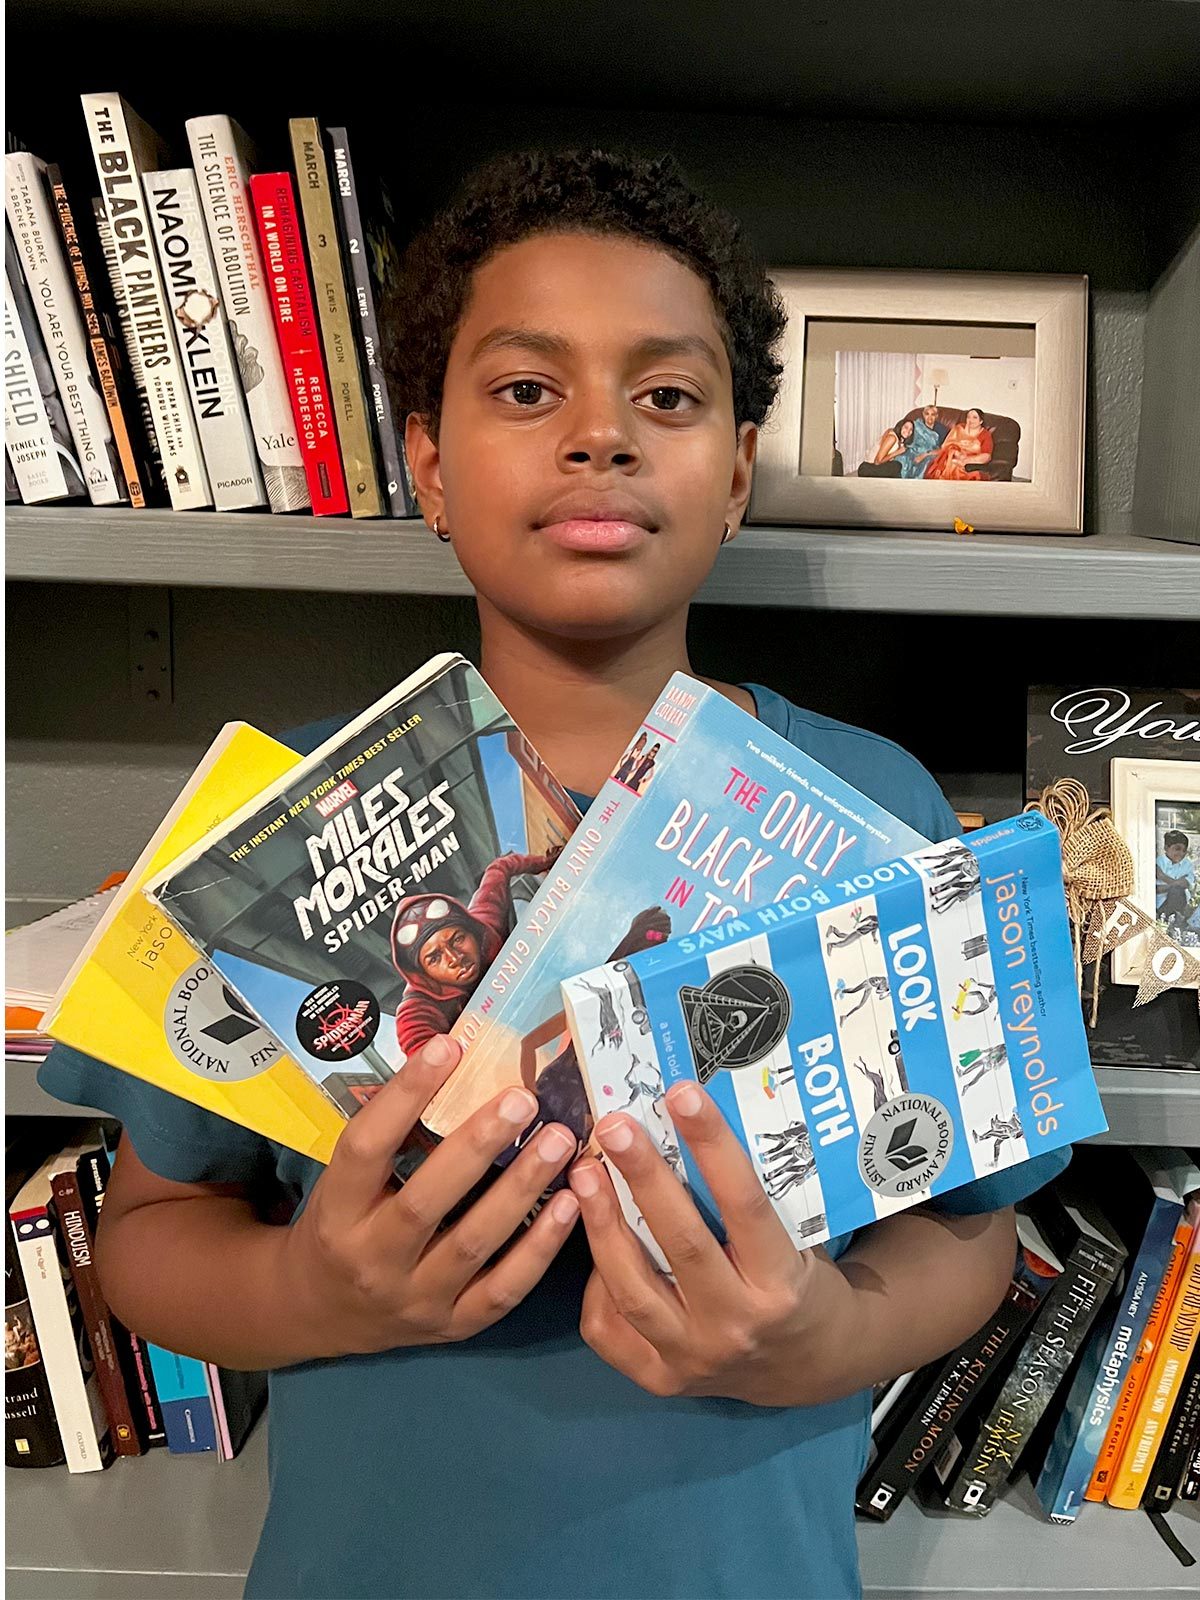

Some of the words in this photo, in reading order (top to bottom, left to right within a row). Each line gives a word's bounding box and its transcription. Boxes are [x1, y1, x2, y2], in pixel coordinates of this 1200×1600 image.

[94, 107, 116, 144] THE
[197, 133, 218, 160] THE
[98, 150, 149, 264] BLACK
[204, 164, 232, 221] SCIENCE
[261, 205, 275, 218] IN
[20, 186, 37, 227] TARANA
[32, 230, 49, 264] BURKE
[217, 225, 235, 241] OF
[224, 155, 239, 190] ERIC
[232, 194, 260, 290] HERSCHTHAL
[22, 232, 38, 271] BROWN
[265, 231, 284, 273] WORLD
[39, 278, 56, 308] YOU
[221, 246, 251, 316] ABOLITION
[274, 276, 289, 293] ON
[303, 140, 321, 190] MARCH
[318, 234, 328, 248] 3
[333, 333, 345, 364] AYDIN
[341, 382, 354, 422] POWELL
[334, 148, 352, 197] MARCH
[350, 239, 360, 254] 2
[372, 383, 385, 423] POWELL
[48, 313, 64, 339] ARE
[125, 269, 171, 369] PANTHERS
[277, 296, 294, 323] FIRE
[55, 344, 74, 381] YOUR
[182, 325, 225, 420] KLEIN
[5, 350, 39, 427] SHIELD
[67, 385, 85, 417] BEST
[293, 368, 317, 450] HENDERSON
[309, 376, 328, 438] REBECCA
[16, 451, 48, 464] JOSEPH
[77, 417, 97, 462] THING
[262, 434, 295, 451] Yale
[217, 476, 253, 489] PICADOR
[229, 844, 251, 863] THE
[248, 814, 290, 852] INSTANT
[288, 796, 312, 819] NEW
[309, 777, 338, 804] YORK
[335, 755, 366, 780] TIMES
[363, 738, 388, 761] BEST
[386, 713, 423, 743] SELLER
[315, 779, 360, 818] MARVEL
[599, 799, 621, 825] THE
[305, 766, 411, 880] MILES
[723, 766, 768, 814] THE
[759, 790, 859, 878] ONLY
[970, 827, 1015, 848] reynolds
[292, 780, 456, 942] MORALES
[570, 827, 603, 878] ONLY
[655, 798, 775, 904] BLACK
[323, 832, 462, 953] SPIDER-MAN
[664, 875, 697, 910] IN
[841, 858, 914, 897] LOOK
[525, 876, 572, 937] BLACK
[136, 924, 173, 971] jaso
[676, 917, 750, 955] WAYS
[499, 940, 531, 996] GIRLS
[887, 922, 938, 1033] LOOK
[480, 998, 495, 1015] IN
[985, 868, 1027, 969] jason
[1010, 978, 1064, 1138] reynolds
[173, 1006, 231, 1074] NATIONAL
[796, 1032, 854, 1147] BOTH
[881, 1099, 942, 1122] NATIONAL
[863, 1133, 887, 1187] FINALIST
[935, 1120, 949, 1159] BOOK
[896, 1160, 939, 1192] AWARD
[64, 1210, 92, 1267] HINDUISM
[1053, 1274, 1097, 1332] FIFTH
[1133, 1271, 1148, 1301] ALYSSA
[981, 1325, 1010, 1358] THE
[938, 1358, 986, 1422] KILLING
[1012, 1331, 1066, 1412] SEASON
[1089, 1325, 1133, 1427] metaphysics
[1120, 1375, 1137, 1411] JONAH
[921, 1382, 953, 1427] JEMISIN
[904, 1424, 943, 1474] MOON
[1169, 1415, 1187, 1455] GREENE
